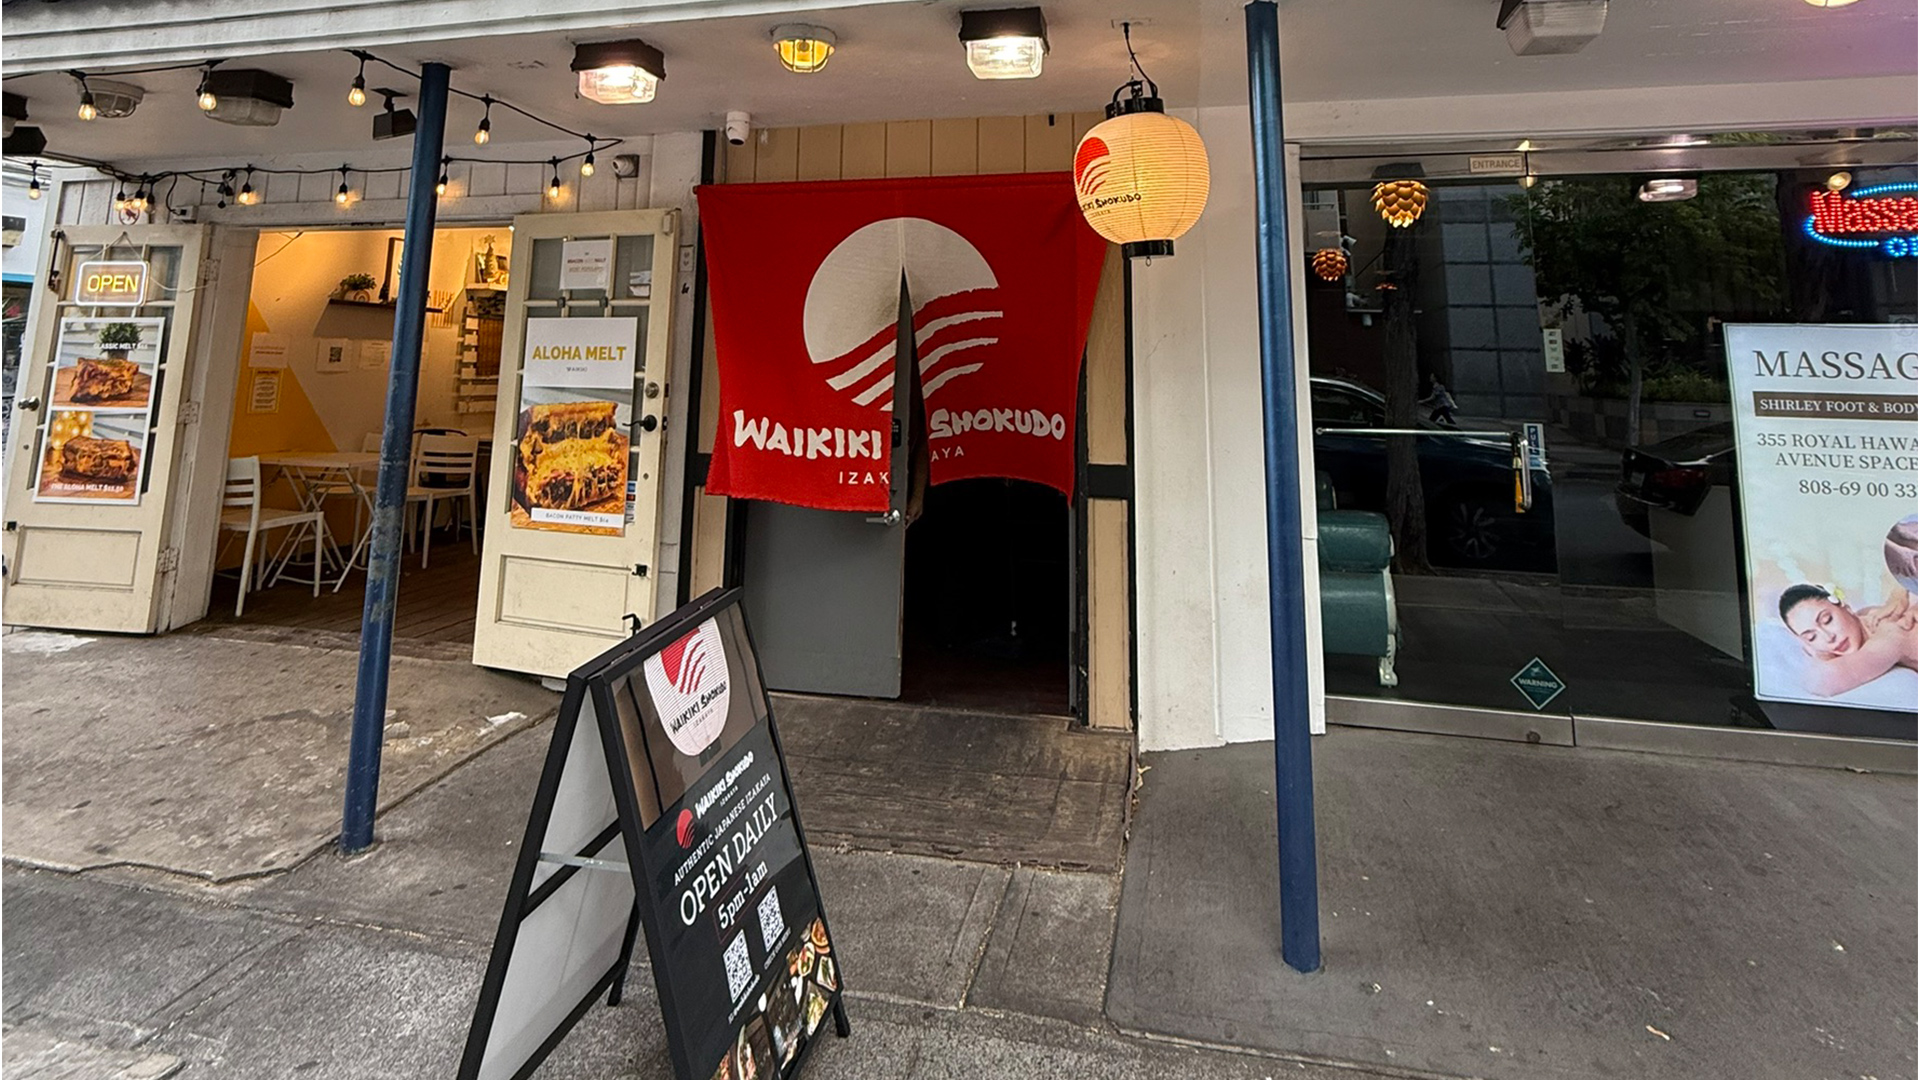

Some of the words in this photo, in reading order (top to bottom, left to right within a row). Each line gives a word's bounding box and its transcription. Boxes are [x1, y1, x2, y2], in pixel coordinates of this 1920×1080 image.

[1472, 159, 1520, 169] ENTRANCE
[1095, 193, 1142, 208] SHOKUDO
[87, 274, 139, 293] OPEN
[532, 345, 582, 360] ALOHA
[585, 346, 627, 361] MELT
[1752, 350, 1918, 381] MASSAG
[1760, 399, 1822, 412] SHIRLEY
[1826, 401, 1866, 413] FOOT
[1868, 402, 1880, 413] &
[1884, 403, 1918, 415] BODY
[732, 409, 882, 460] WAIKIKI
[928, 408, 1066, 441] SHOKUDO
[1757, 433, 1787, 447] 355
[1792, 434, 1857, 449] ROYAL
[1775, 453, 1855, 469] AVENUE
[1859, 455, 1918, 471] SPACE
[86, 484, 104, 492] MELT
[1799, 479, 1861, 496] 808-69
[1867, 482, 1889, 497] 00
[1518, 678, 1558, 689] WARNING
[670, 701, 700, 734] WAIKIKI
[694, 778, 727, 819] WAIKIKI
[725, 750, 754, 787] SHOKUDO
[673, 833, 715, 887] AUTHENTIC
[714, 798, 745, 840] JAPANESE
[744, 773, 771, 806] IZAKAYA
[680, 844, 733, 926] OPEN
[731, 791, 778, 865] DAILY
[718, 860, 768, 930] 5pm-1am
